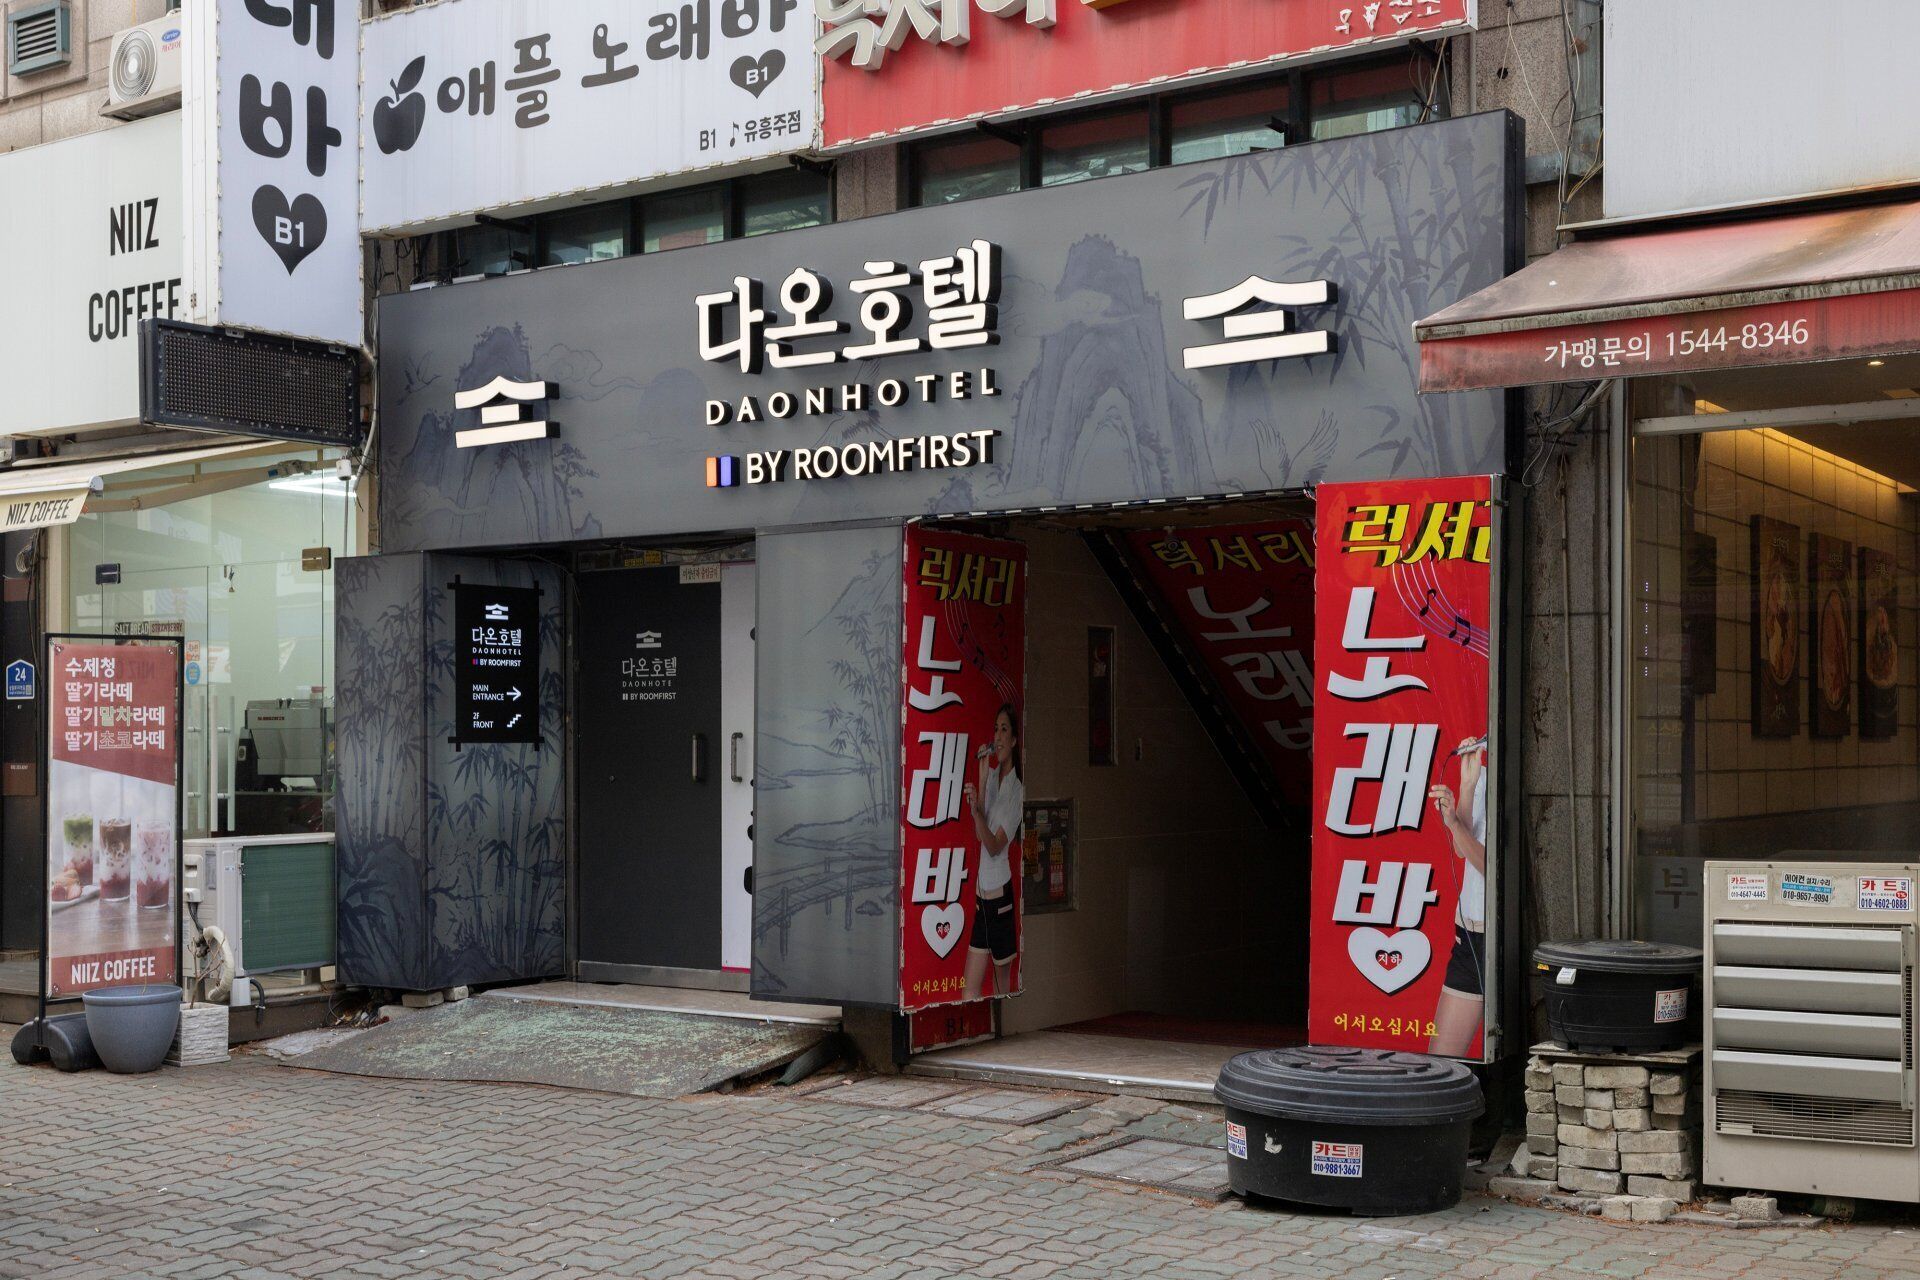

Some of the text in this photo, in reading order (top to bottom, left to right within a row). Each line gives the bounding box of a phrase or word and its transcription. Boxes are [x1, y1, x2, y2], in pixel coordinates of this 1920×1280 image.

[437, 33, 561, 129] 애플
[745, 67, 770, 86] B1
[743, 110, 801, 143] 유흥주점
[699, 129, 717, 151] B1
[110, 197, 159, 256] NIIZ
[275, 216, 305, 248] B1
[695, 239, 1001, 373] 다온호텔
[1545, 319, 1809, 369] 가맹문의 1544-8346
[706, 368, 1001, 426] DAONHOTEL
[747, 450, 790, 484] BY
[6, 498, 74, 526] NIIZ COFFEE
[1342, 500, 1490, 567] 럭셔
[919, 547, 1017, 605] 럭셔리
[472, 626, 522, 647] 다온호텔
[472, 647, 522, 655] DAONHOTEL
[65, 657, 116, 679] 수제청
[480, 659, 487, 667] BY
[622, 656, 677, 678] 다온호텔
[15, 668, 26, 681] 24
[65, 682, 133, 702] 딸기라떼
[472, 684, 489, 692] MAIN
[472, 693, 504, 701] ENTRANCE
[630, 693, 638, 701] BY
[65, 706, 165, 727] 딸기말차라떼
[472, 712, 480, 720] 2F
[473, 721, 494, 729] FRONT
[65, 730, 165, 751] 딸기초코라떼
[1731, 876, 1747, 884] 카드
[1784, 874, 1804, 883] 에어컨
[1862, 880, 1897, 891] 카드
[1378, 952, 1401, 966] 지하
[71, 956, 156, 985] NIIZ COFFEE
[912, 976, 967, 995] 어서오십시요
[1334, 1013, 1439, 1038] 어서오십시요
[1315, 1143, 1346, 1157] 카드
